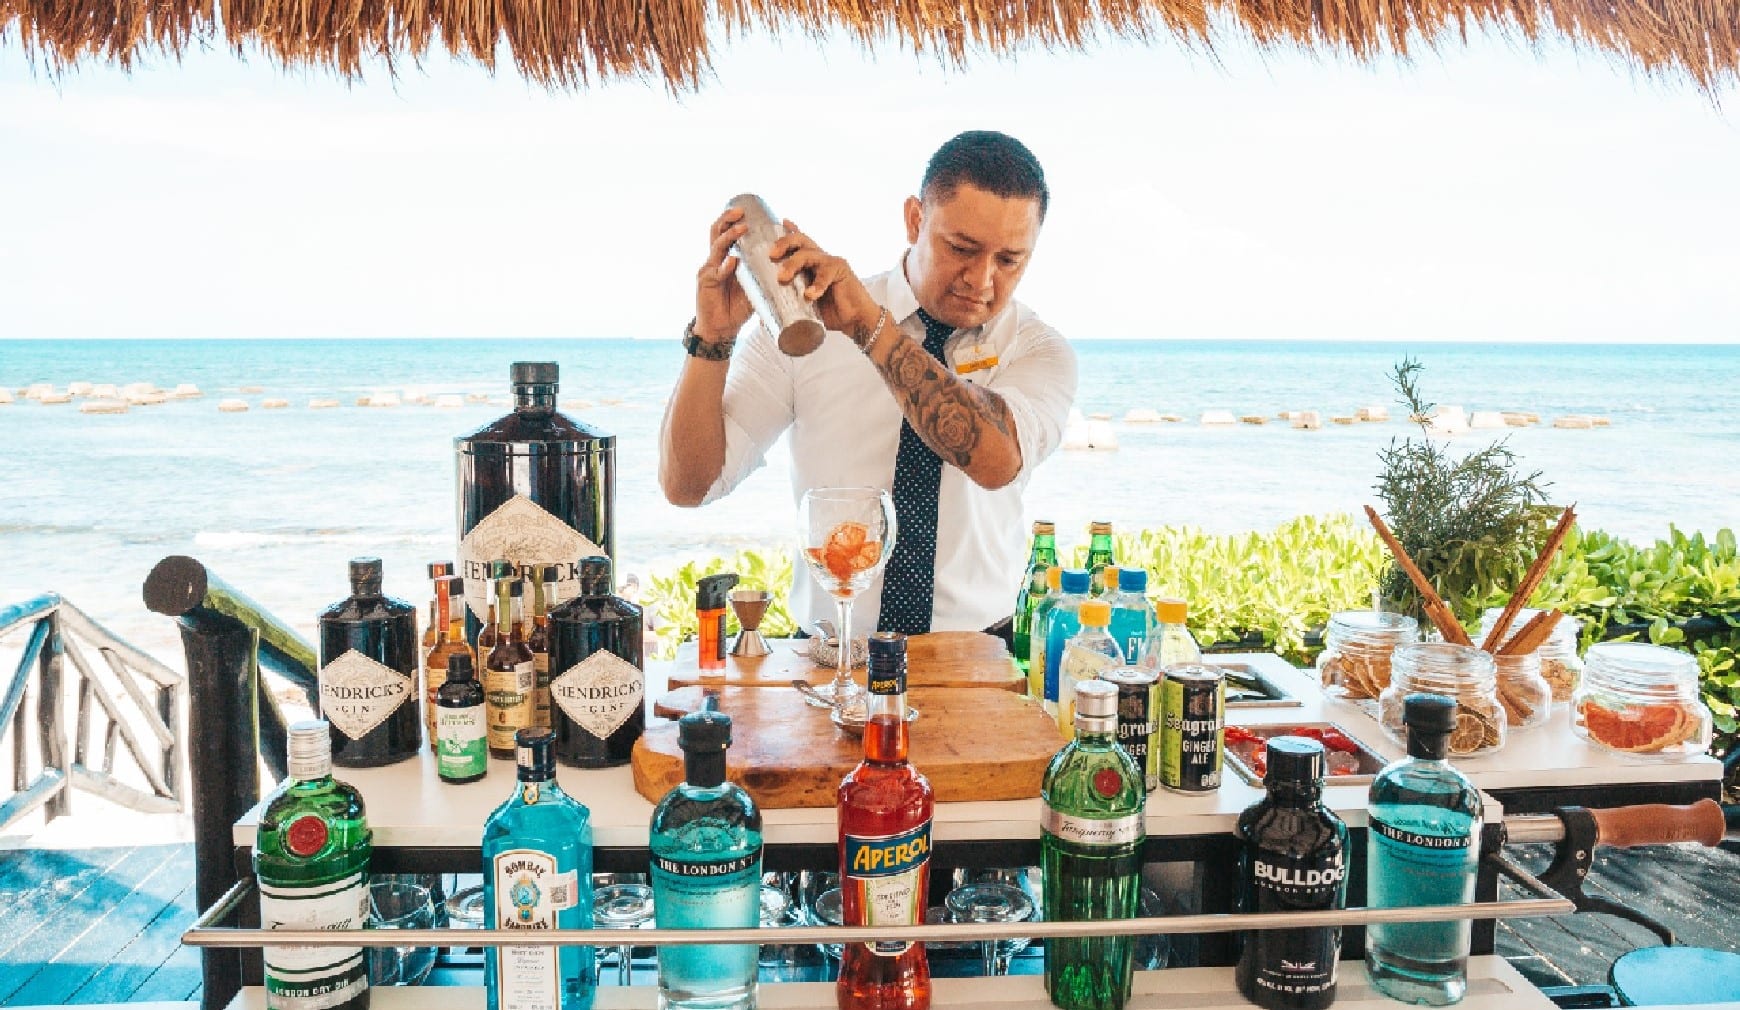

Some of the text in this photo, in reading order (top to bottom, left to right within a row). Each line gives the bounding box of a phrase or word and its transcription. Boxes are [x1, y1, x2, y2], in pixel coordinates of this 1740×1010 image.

[341, 705, 370, 713] GIN
[589, 704, 617, 713] GIN
[1182, 740, 1217, 753] GINGER
[1191, 753, 1209, 765] ALE
[1381, 824, 1403, 840] THE
[1406, 833, 1460, 847] LONDON
[853, 834, 929, 871] APEROL
[660, 858, 679, 874] THE
[683, 860, 736, 875] LONDON
[1254, 860, 1345, 886] BULLDOG
